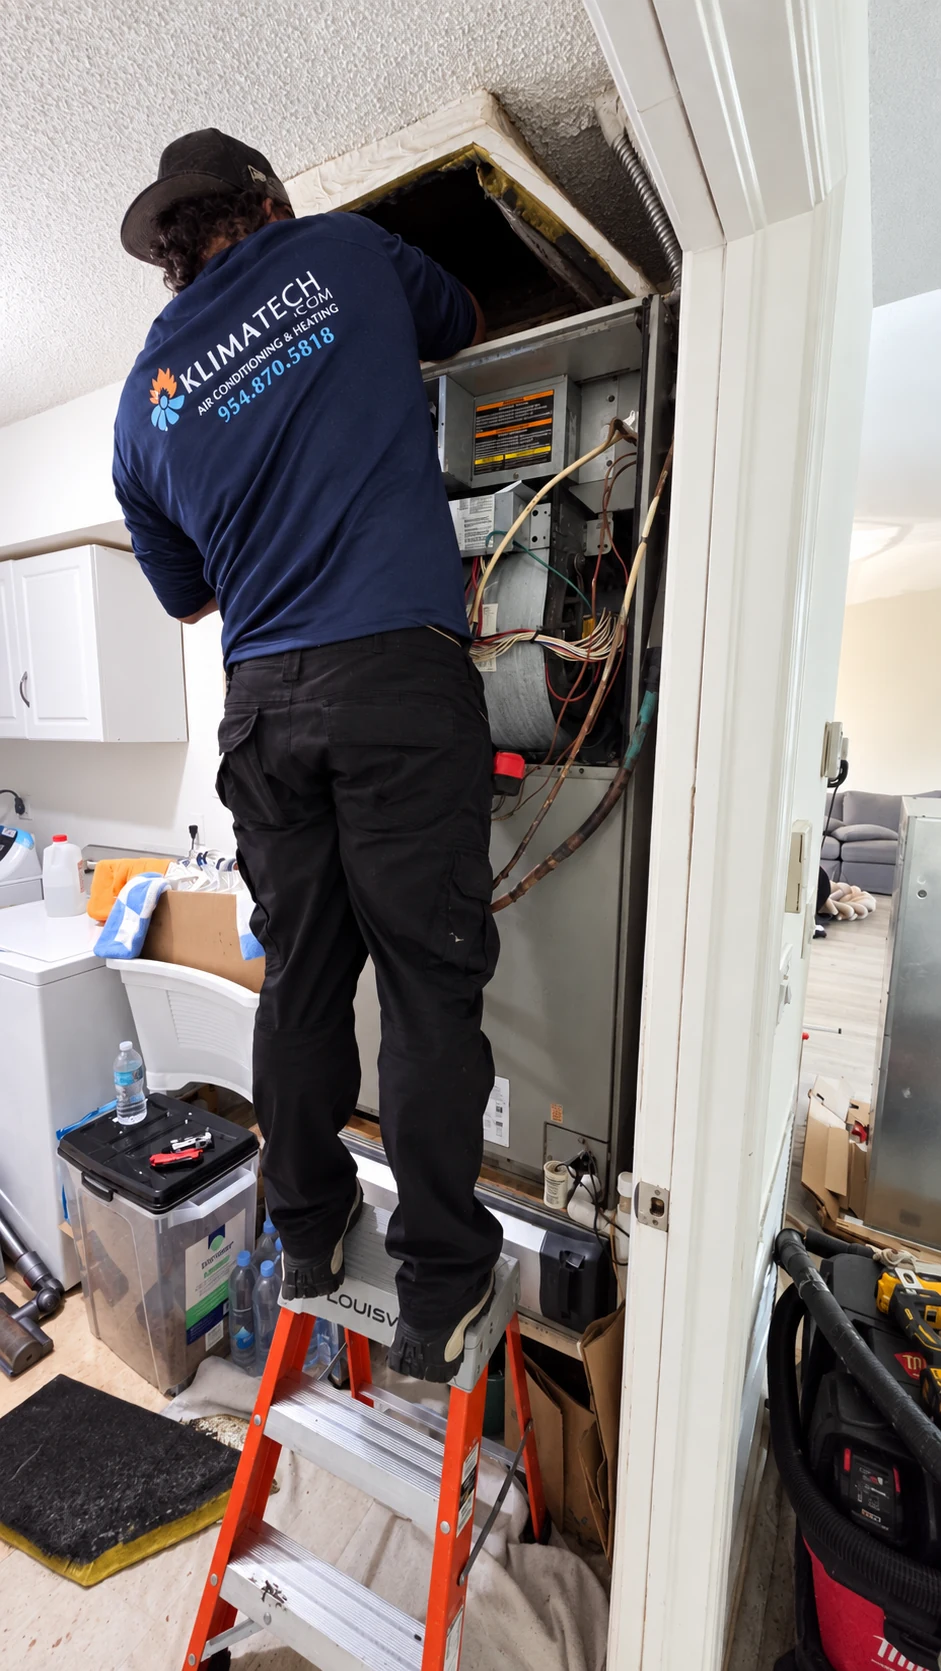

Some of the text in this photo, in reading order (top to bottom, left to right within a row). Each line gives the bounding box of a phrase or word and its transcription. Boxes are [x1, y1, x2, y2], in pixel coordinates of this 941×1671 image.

[179, 271, 321, 394] KLIMATECH
[294, 288, 333, 318] .COM
[197, 303, 339, 416] AIR CONDITIONING & HEATING
[217, 326, 335, 423] 954.870.5818
